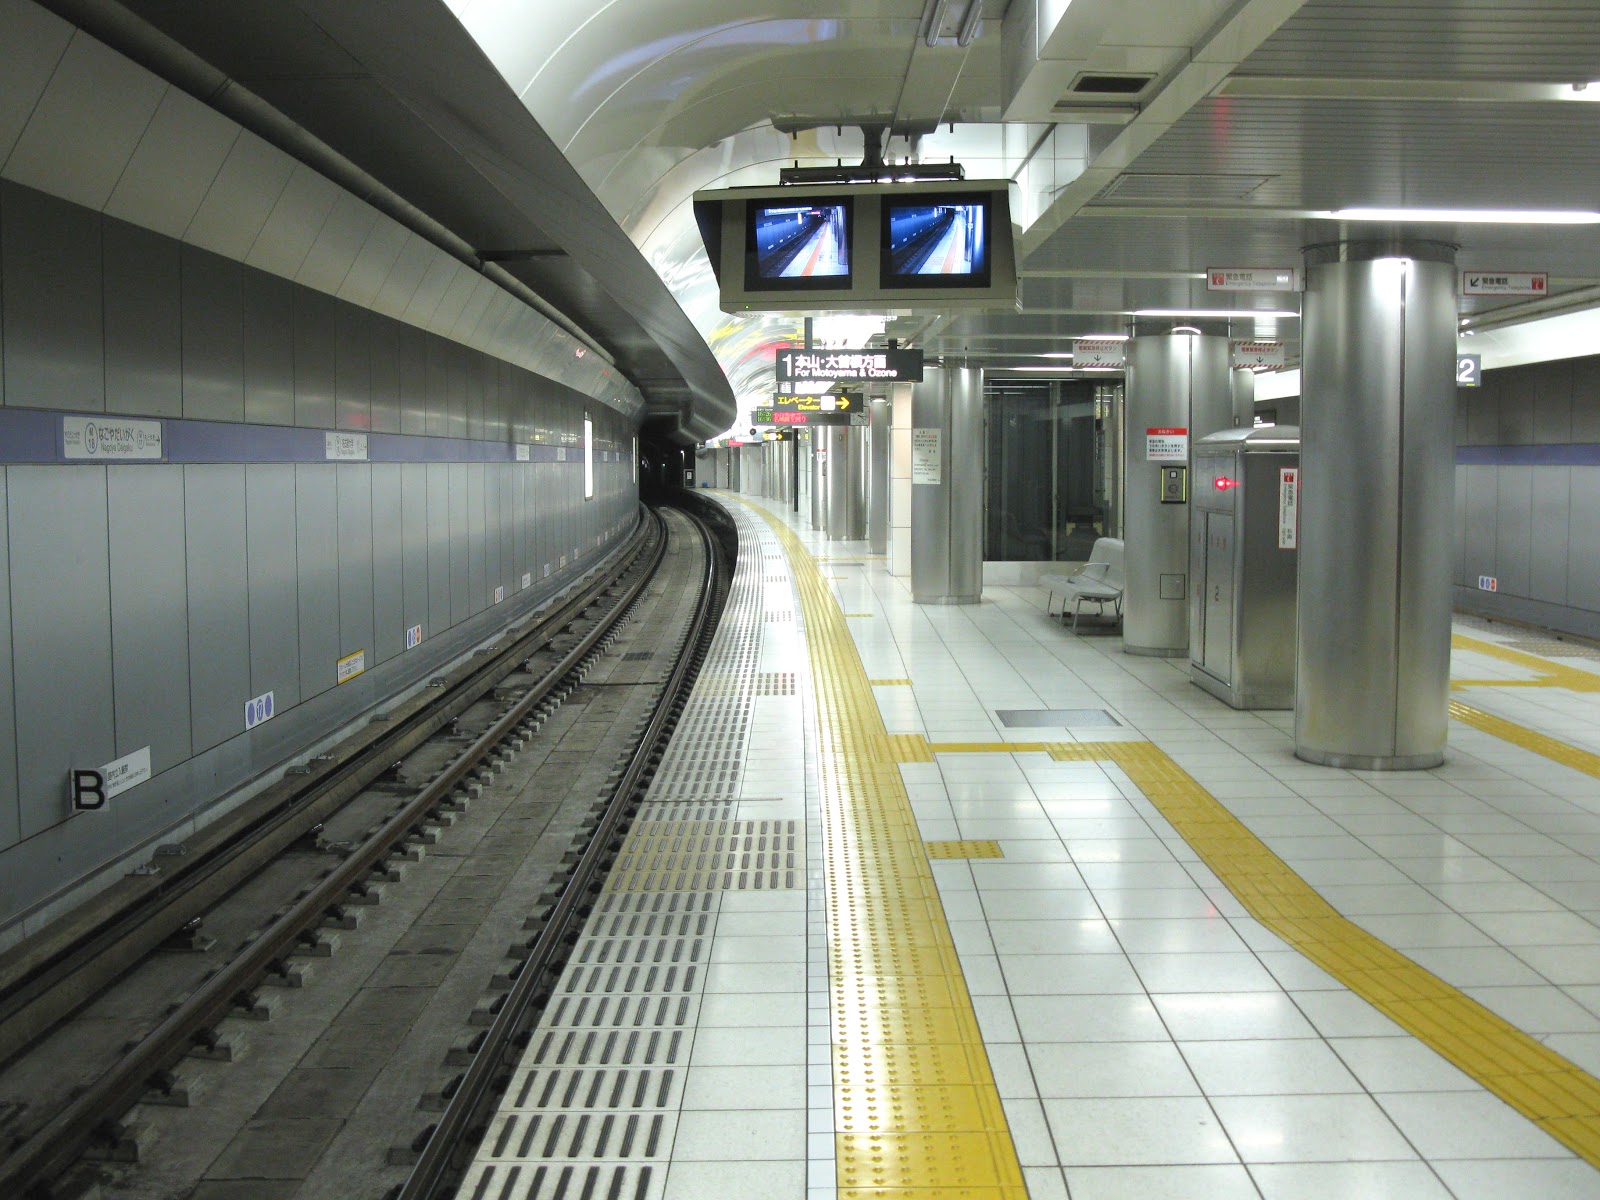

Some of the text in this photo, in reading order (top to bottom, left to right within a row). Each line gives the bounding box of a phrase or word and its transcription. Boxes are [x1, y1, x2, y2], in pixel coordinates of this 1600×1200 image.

[782, 354, 792, 377] 1
[795, 369, 898, 378] For Motoyama & Ozone
[1459, 359, 1475, 382] 2
[778, 396, 821, 405] エレベーター
[74, 770, 105, 810] B
